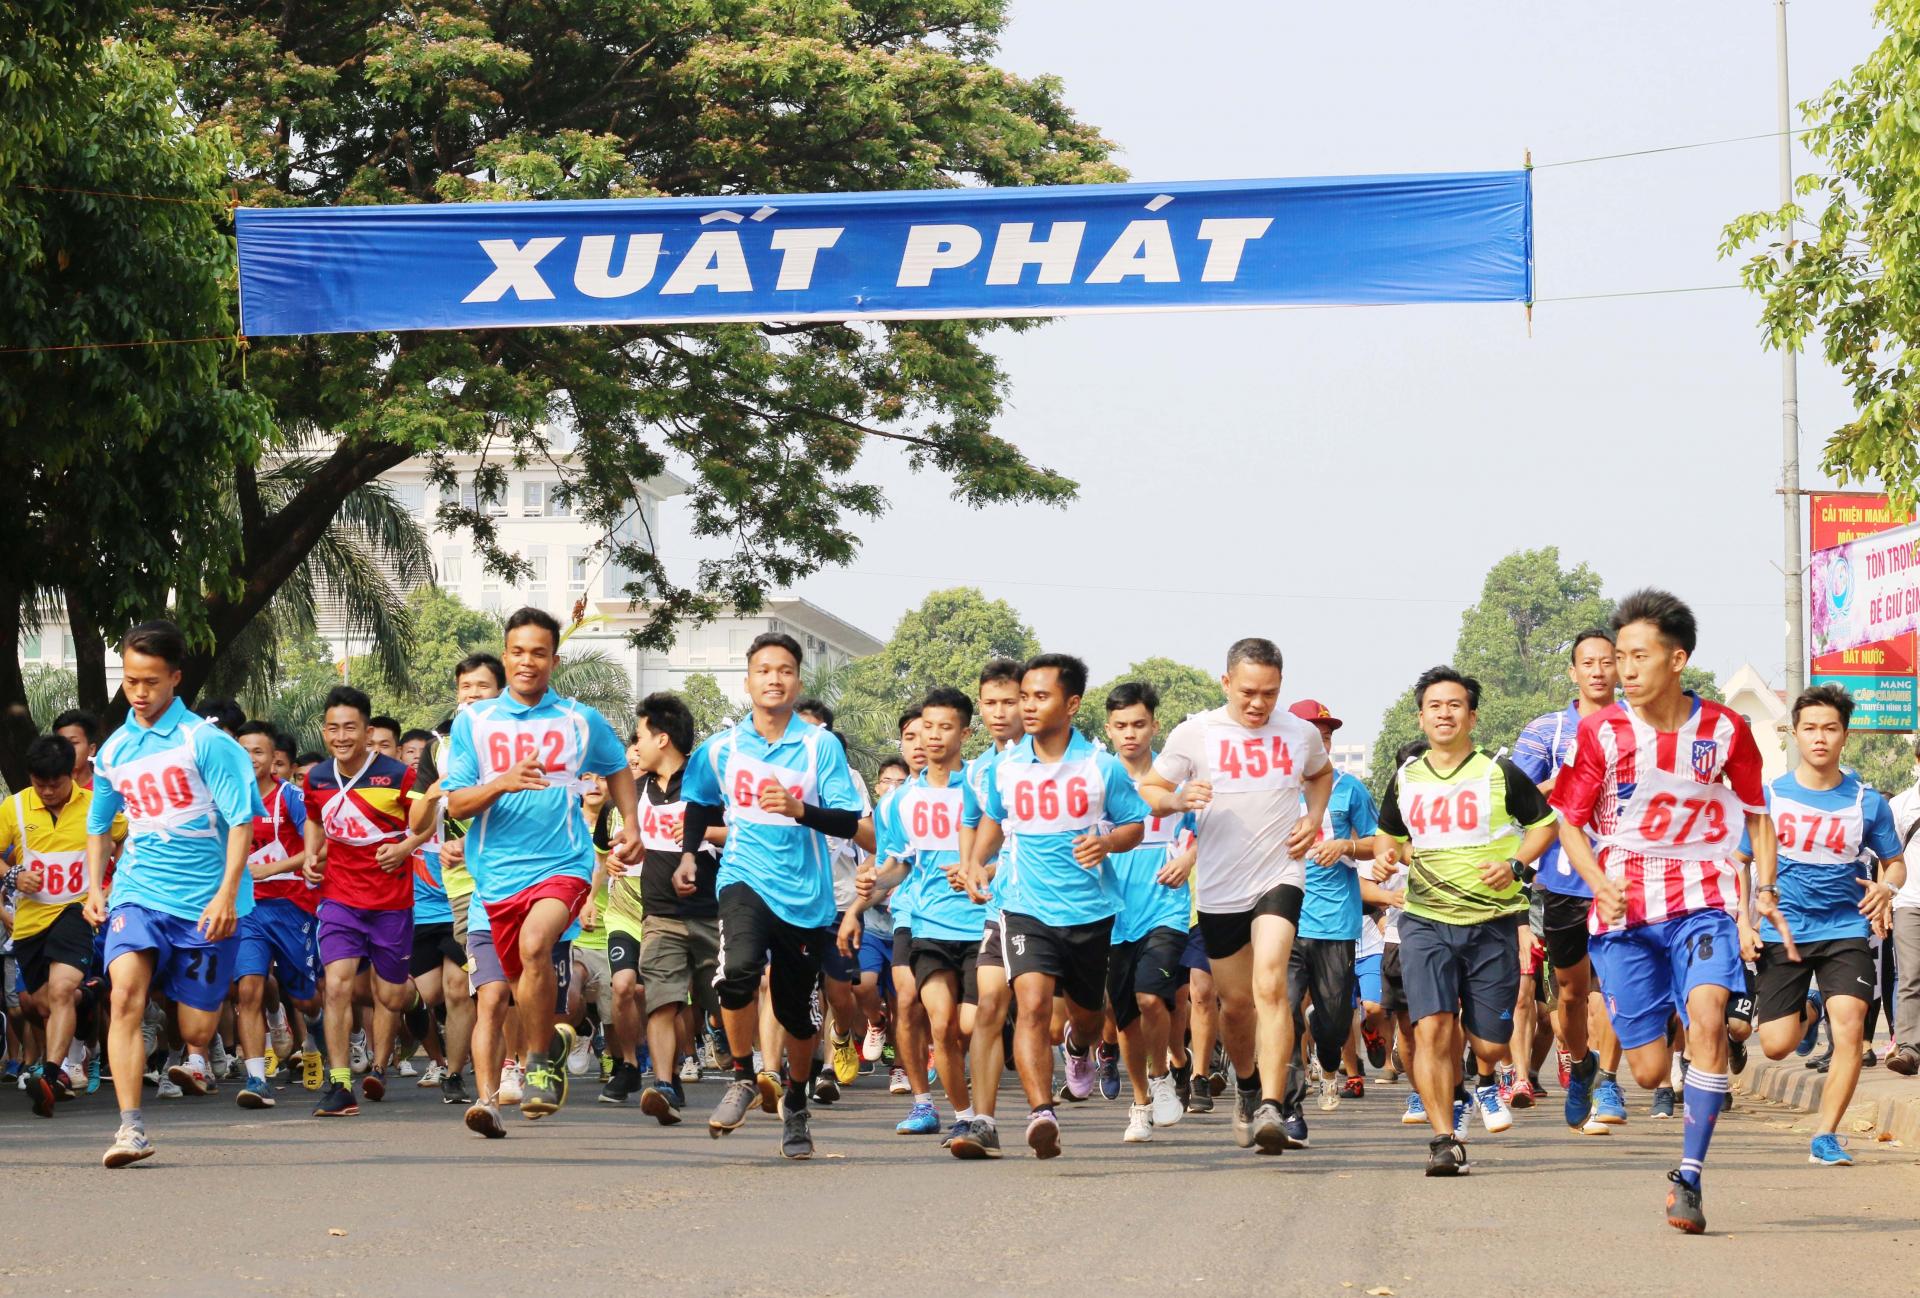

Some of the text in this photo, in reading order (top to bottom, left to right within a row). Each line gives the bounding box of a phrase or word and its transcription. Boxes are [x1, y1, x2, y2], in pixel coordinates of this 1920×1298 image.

[461, 194, 1274, 303] XUẤT PHÁT
[1822, 504, 1836, 522] CẢI
[1838, 506, 1862, 525] THIỆN
[1865, 508, 1890, 526] MẠNH
[490, 730, 566, 773] 662
[1220, 736, 1293, 779] 454
[119, 766, 193, 819] 660
[369, 776, 392, 786] T90
[1015, 777, 1089, 822] 666
[643, 805, 687, 840] 45
[1409, 790, 1478, 834] 446
[1640, 791, 1728, 846] 673
[1778, 812, 1846, 854] 674
[555, 960, 567, 987] 9
[1735, 999, 1752, 1016] 12
